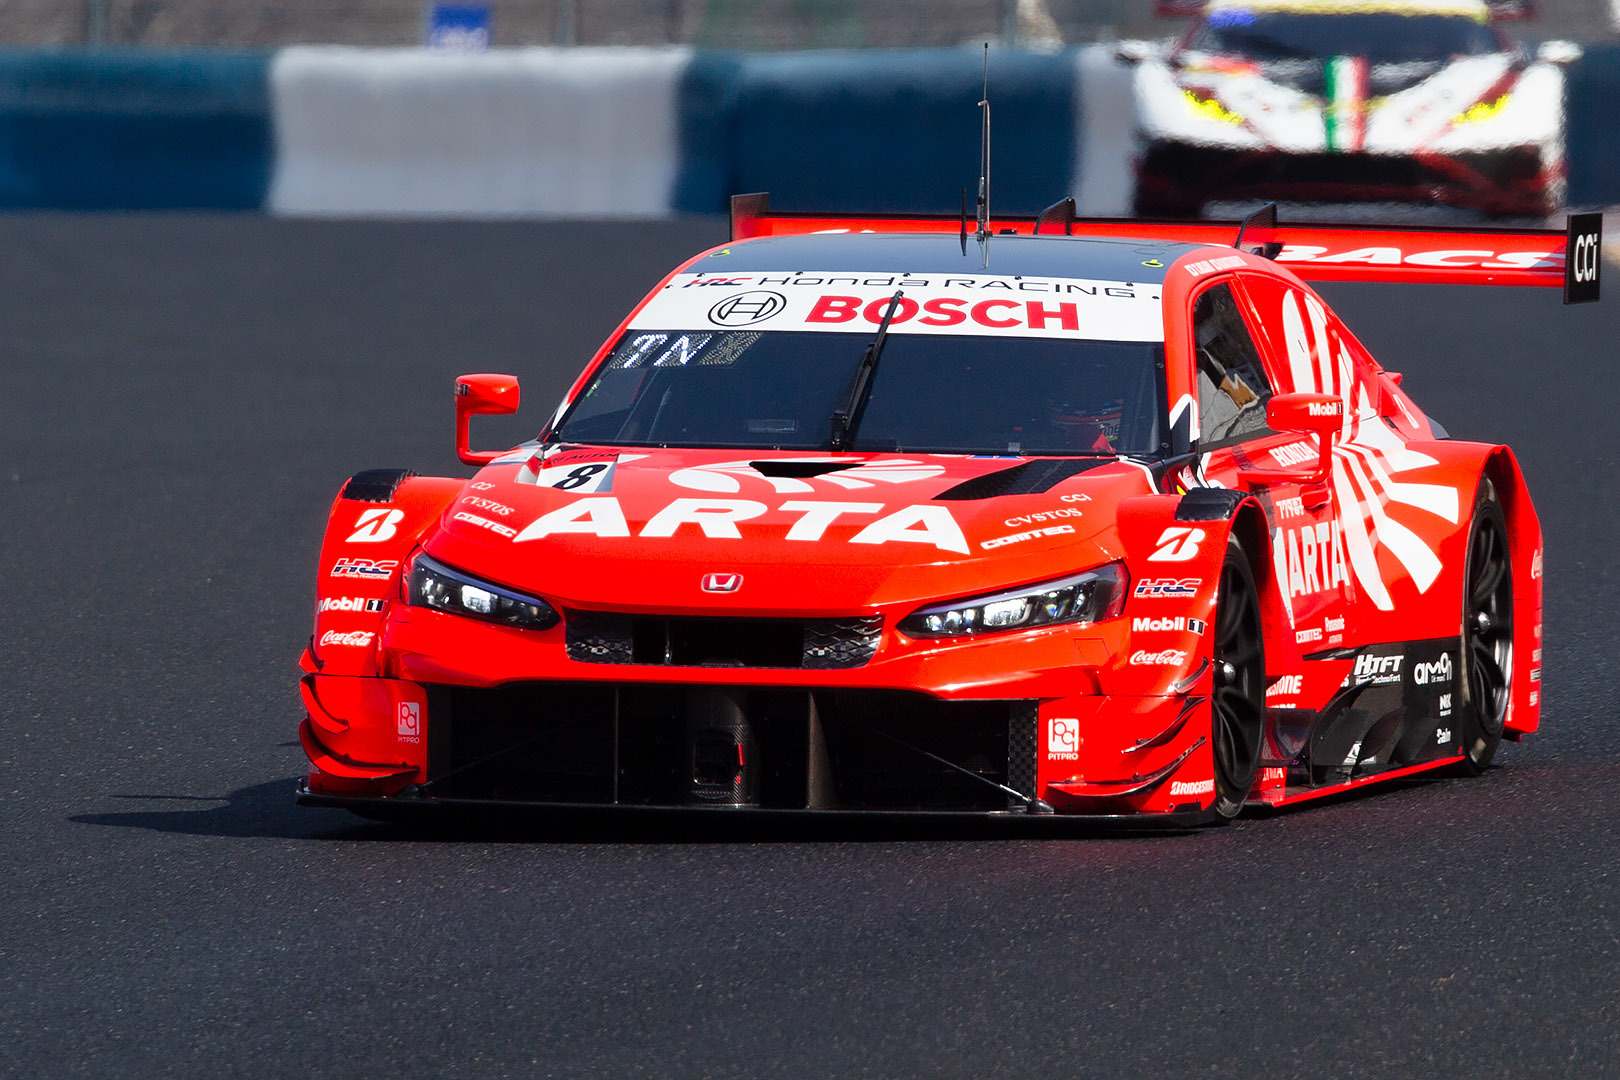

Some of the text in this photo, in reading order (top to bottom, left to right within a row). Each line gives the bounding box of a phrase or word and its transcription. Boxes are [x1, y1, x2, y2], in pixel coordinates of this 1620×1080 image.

[682, 277, 1136, 298] HRC Honda RACING
[804, 295, 1080, 331] BOSCH
[1308, 402, 1337, 416] Mobil
[1269, 441, 1320, 468] HONDA
[551, 464, 609, 490] 8
[461, 495, 516, 516] CVSTOS
[512, 497, 971, 555] ARTA
[1004, 507, 1083, 527] CVSTOS
[980, 524, 1076, 550] COMTEC
[331, 557, 399, 576] HRC
[1288, 519, 1351, 598] ARTA
[1134, 578, 1203, 594] HRC
[318, 597, 365, 613] Mobil
[1133, 616, 1186, 632] Mobil
[1047, 752, 1079, 761] PITPRO
